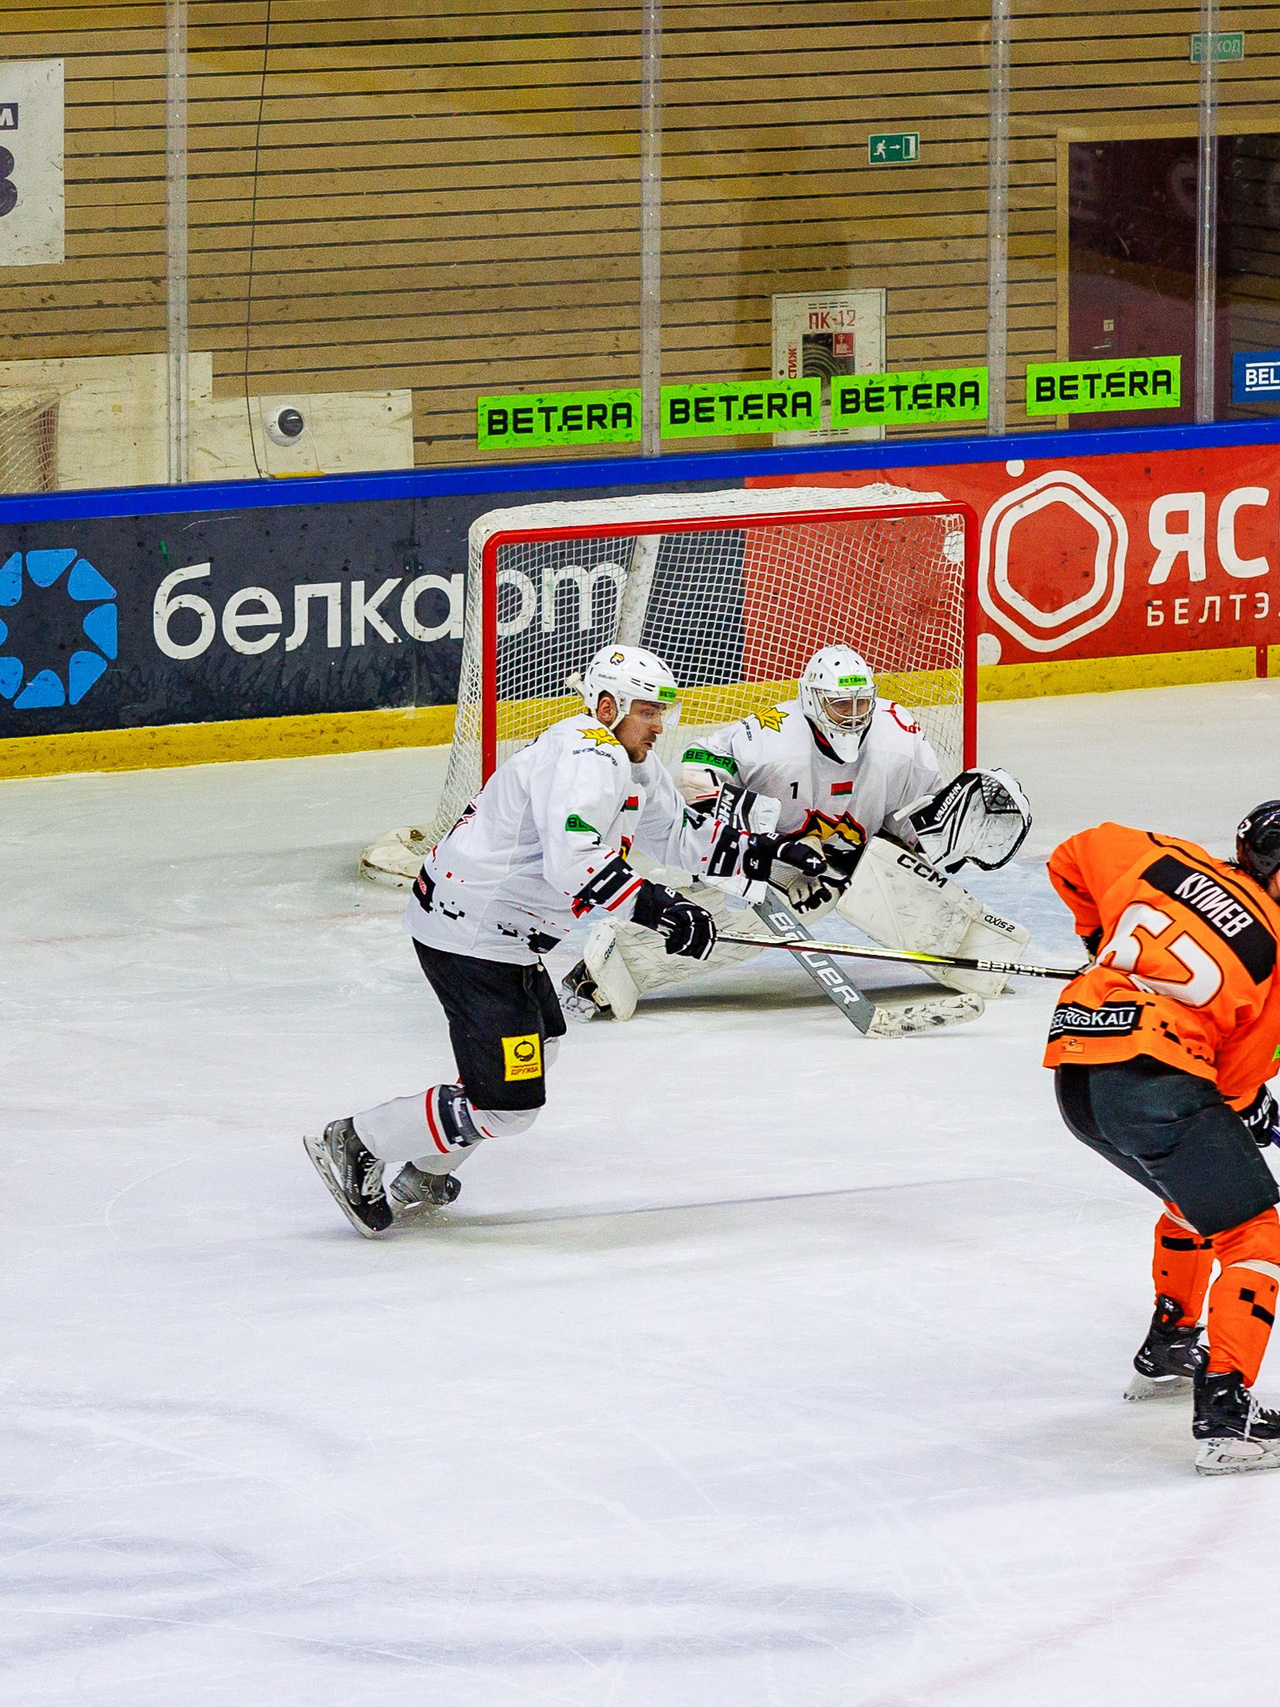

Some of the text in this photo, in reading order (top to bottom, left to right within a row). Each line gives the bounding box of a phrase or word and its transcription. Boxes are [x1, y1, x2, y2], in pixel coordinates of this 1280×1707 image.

[1194, 39, 1241, 55] ВХОД
[808, 310, 856, 329] ПК-12
[789, 781, 799, 800] 1
[933, 782, 962, 823] VAUGHN
[897, 853, 949, 889] CCM
[1174, 872, 1254, 938] КУЛИЕВ
[1050, 1010, 1135, 1030] ELRUSKALI
